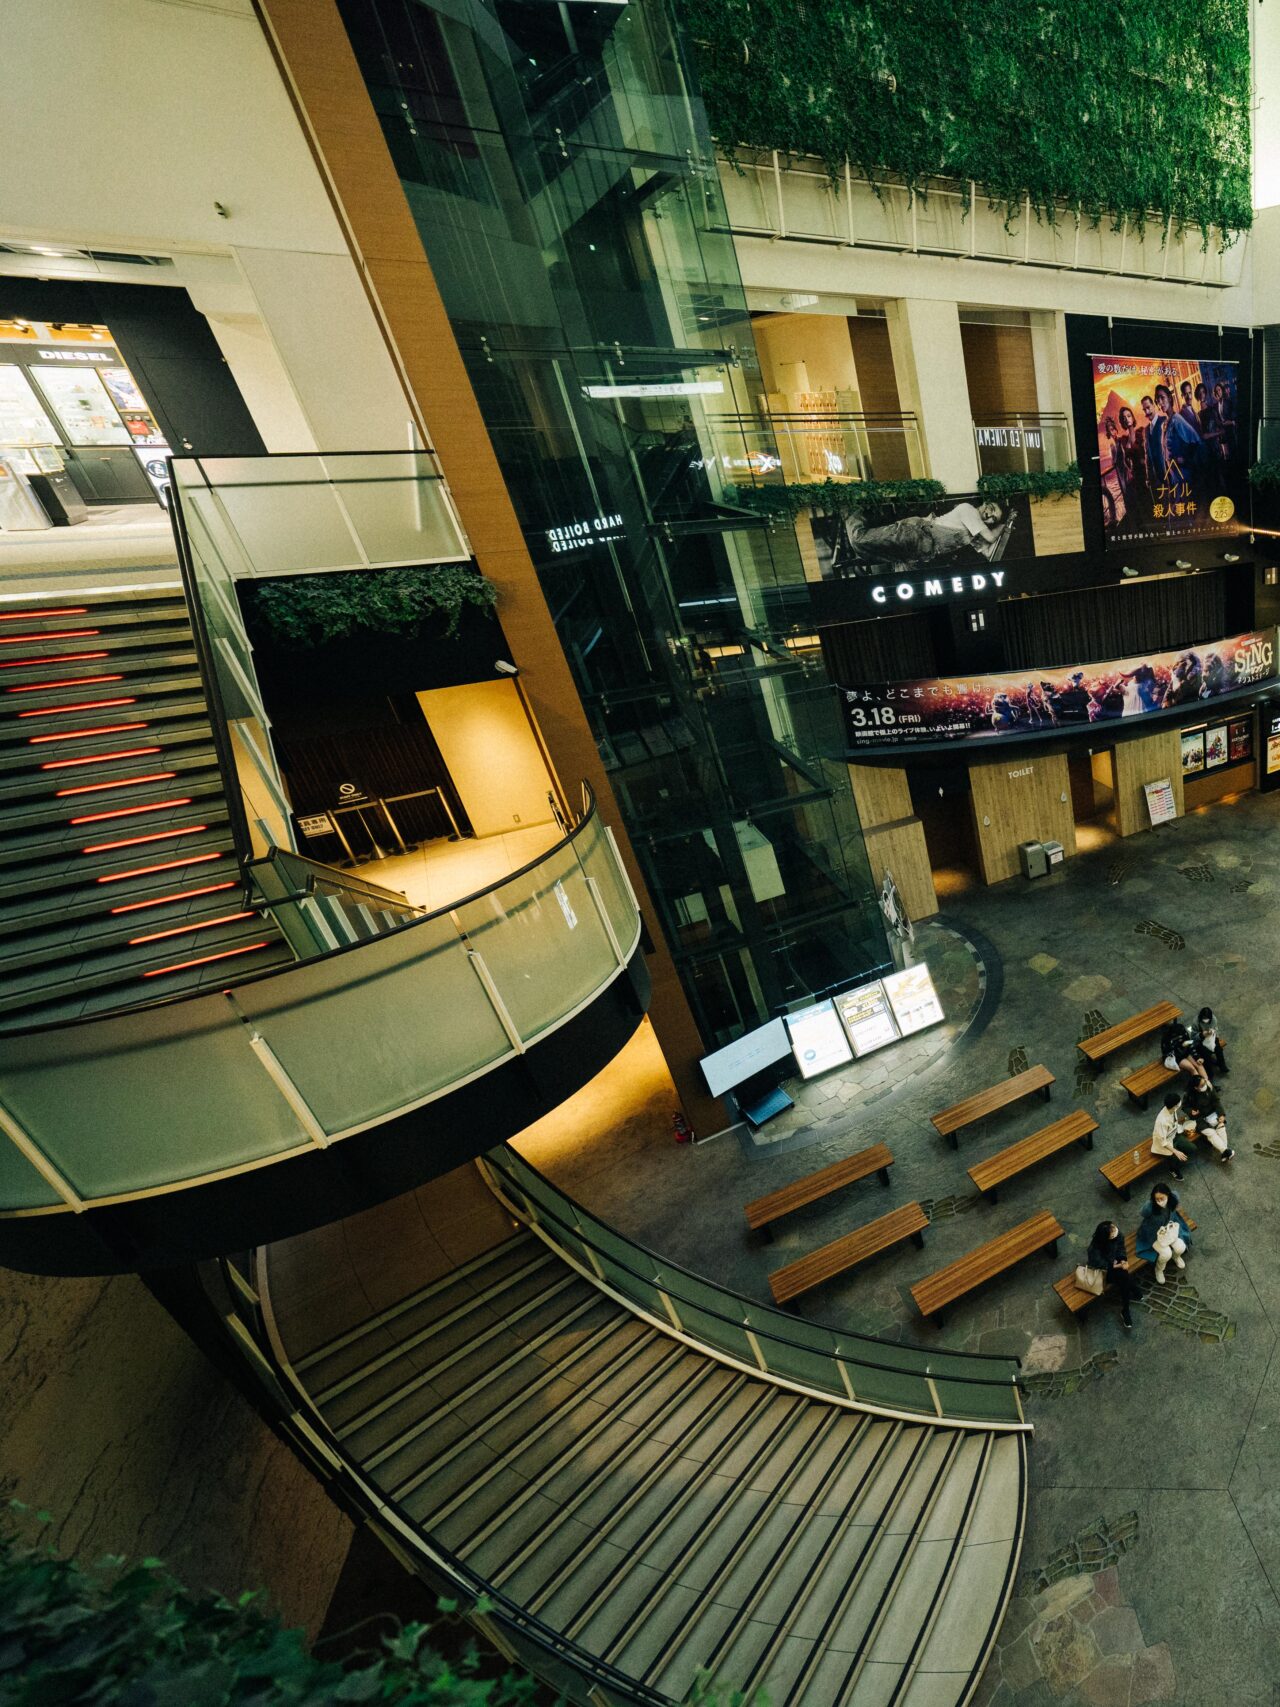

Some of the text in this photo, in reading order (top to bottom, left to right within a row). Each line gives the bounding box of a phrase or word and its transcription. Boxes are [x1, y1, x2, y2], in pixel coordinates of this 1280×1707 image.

[37, 349, 115, 362] DIESEL
[1155, 482, 1192, 500] ナイル
[1152, 501, 1198, 518] 殺人事件
[871, 571, 1006, 603] COMEDY
[1234, 641, 1273, 673] SING
[850, 706, 921, 727] 3.18 (FRI)
[1008, 765, 1034, 779] TOILET
